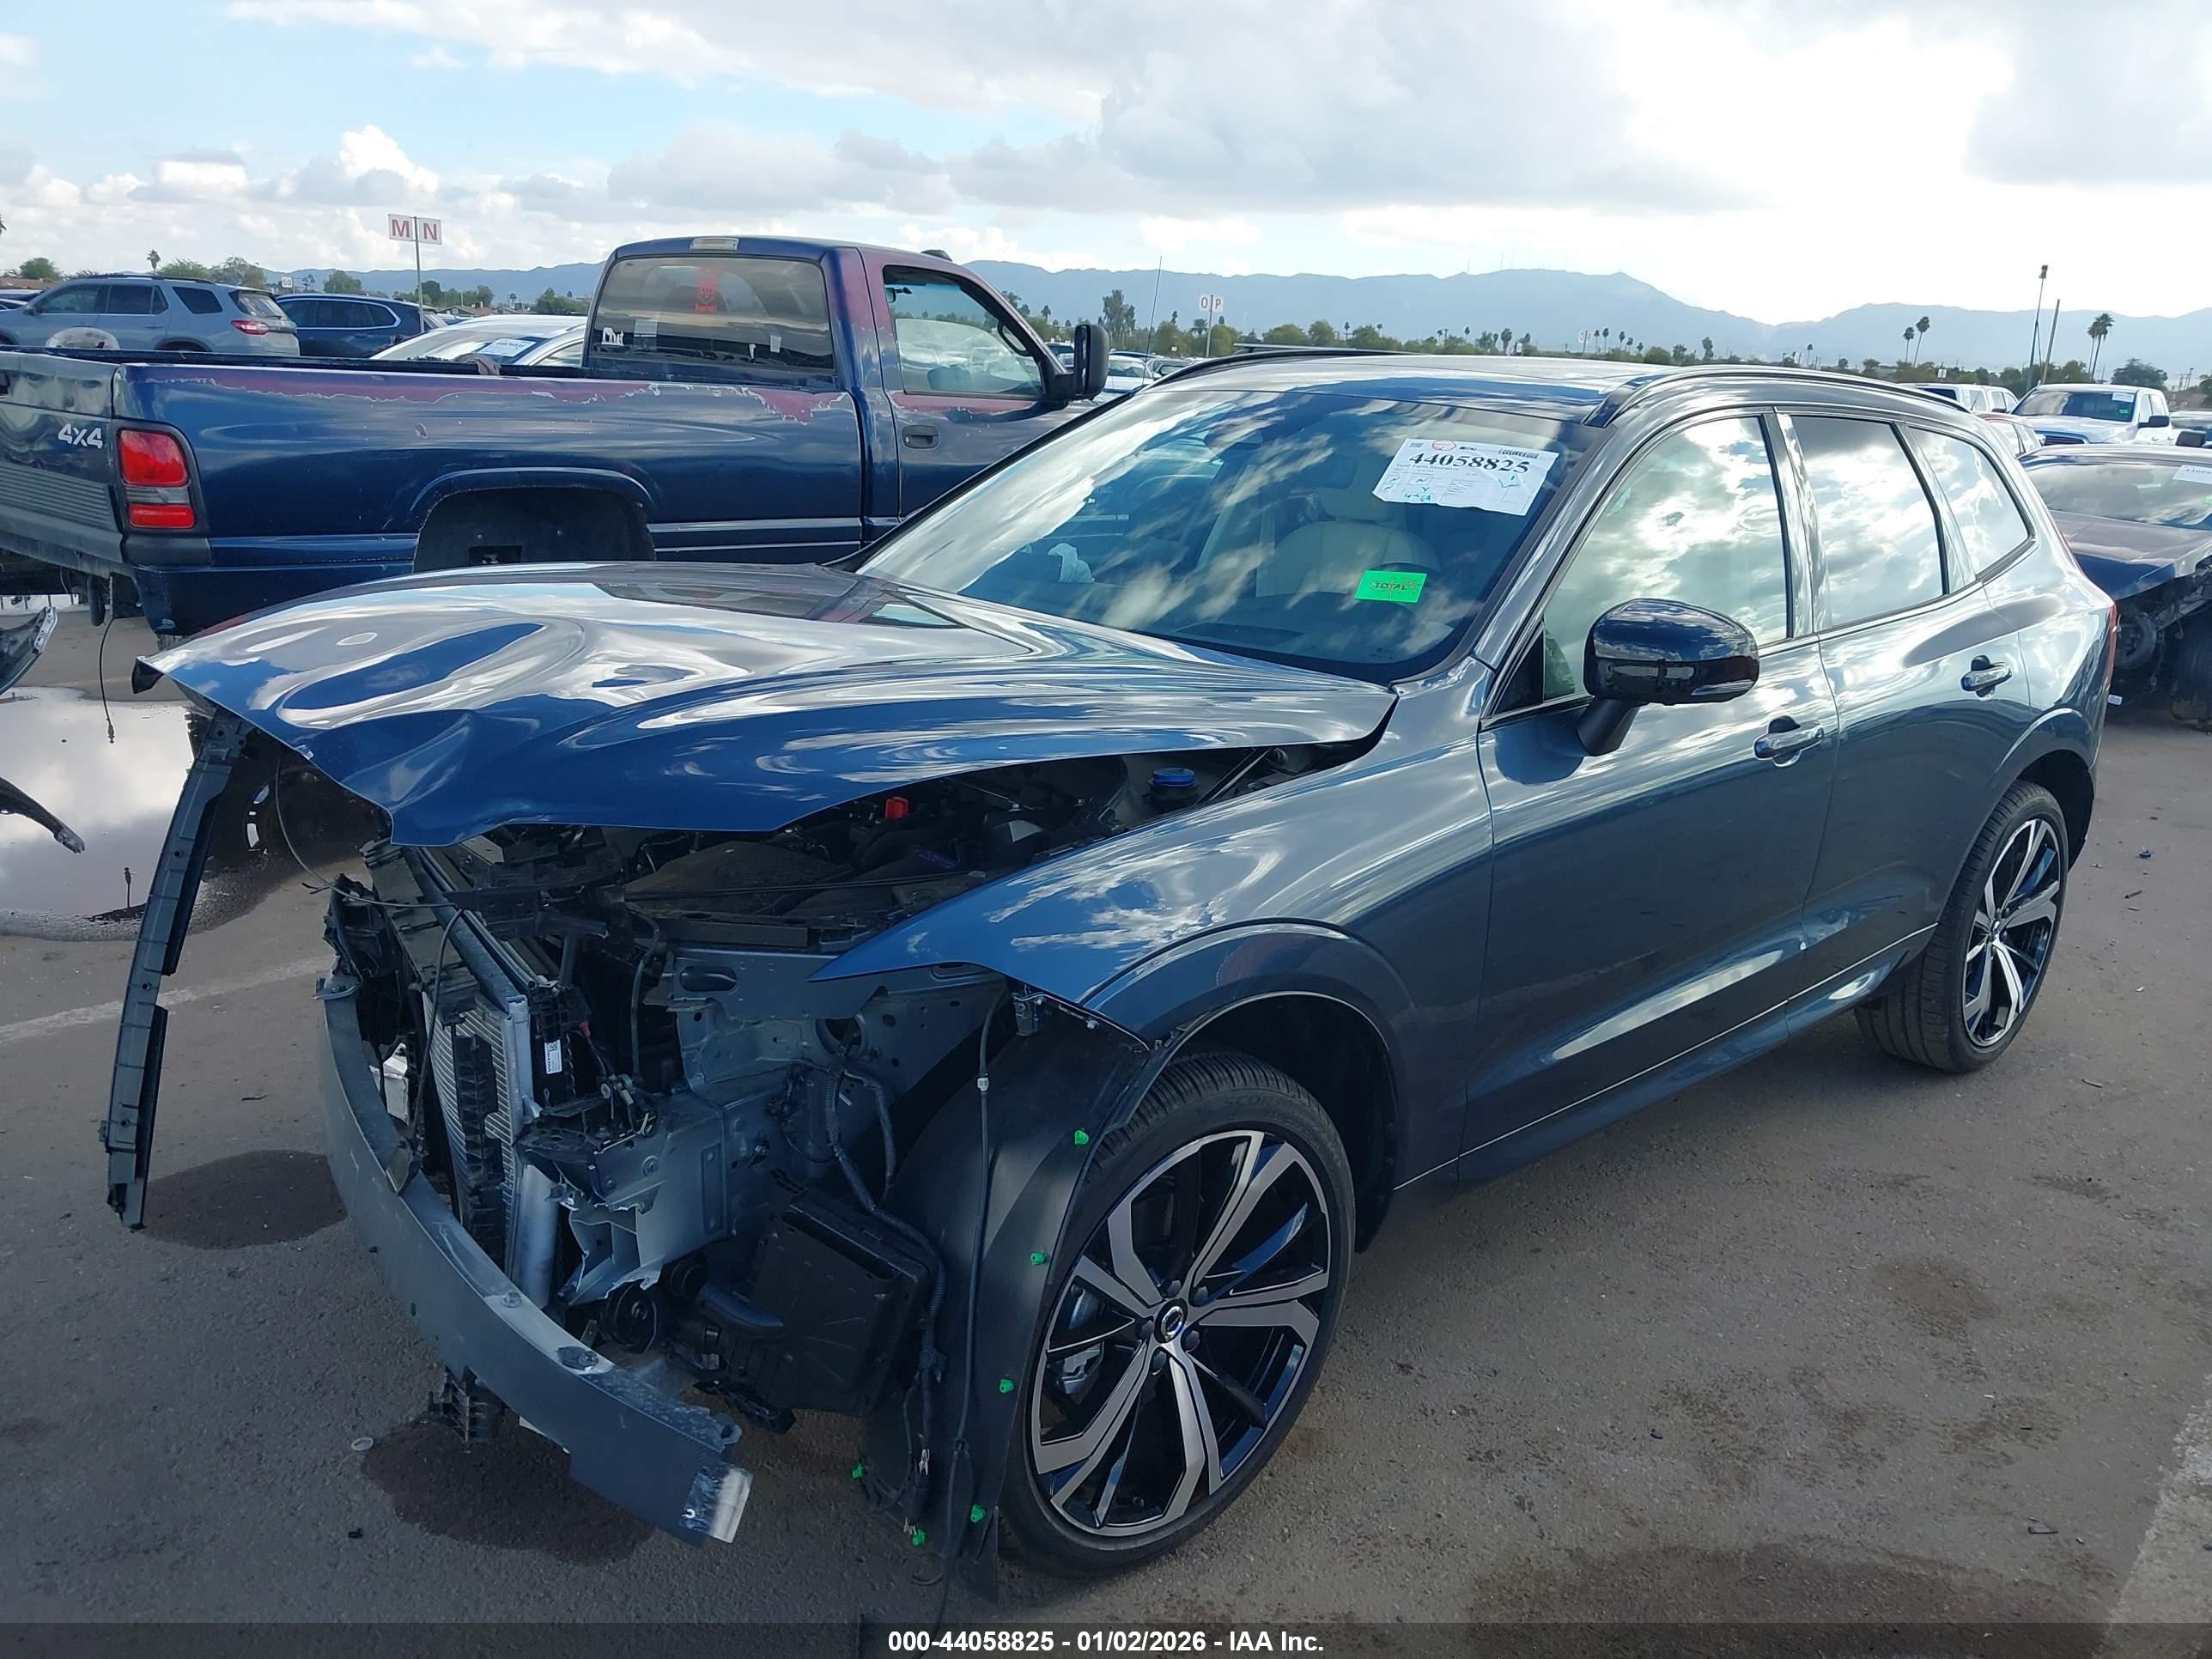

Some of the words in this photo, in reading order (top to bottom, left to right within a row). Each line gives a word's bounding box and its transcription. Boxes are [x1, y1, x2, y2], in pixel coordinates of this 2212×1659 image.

[392, 219, 410, 237] M
[423, 222, 437, 240] N
[1215, 298, 1222, 309] P
[1409, 453, 1530, 474] 44058825
